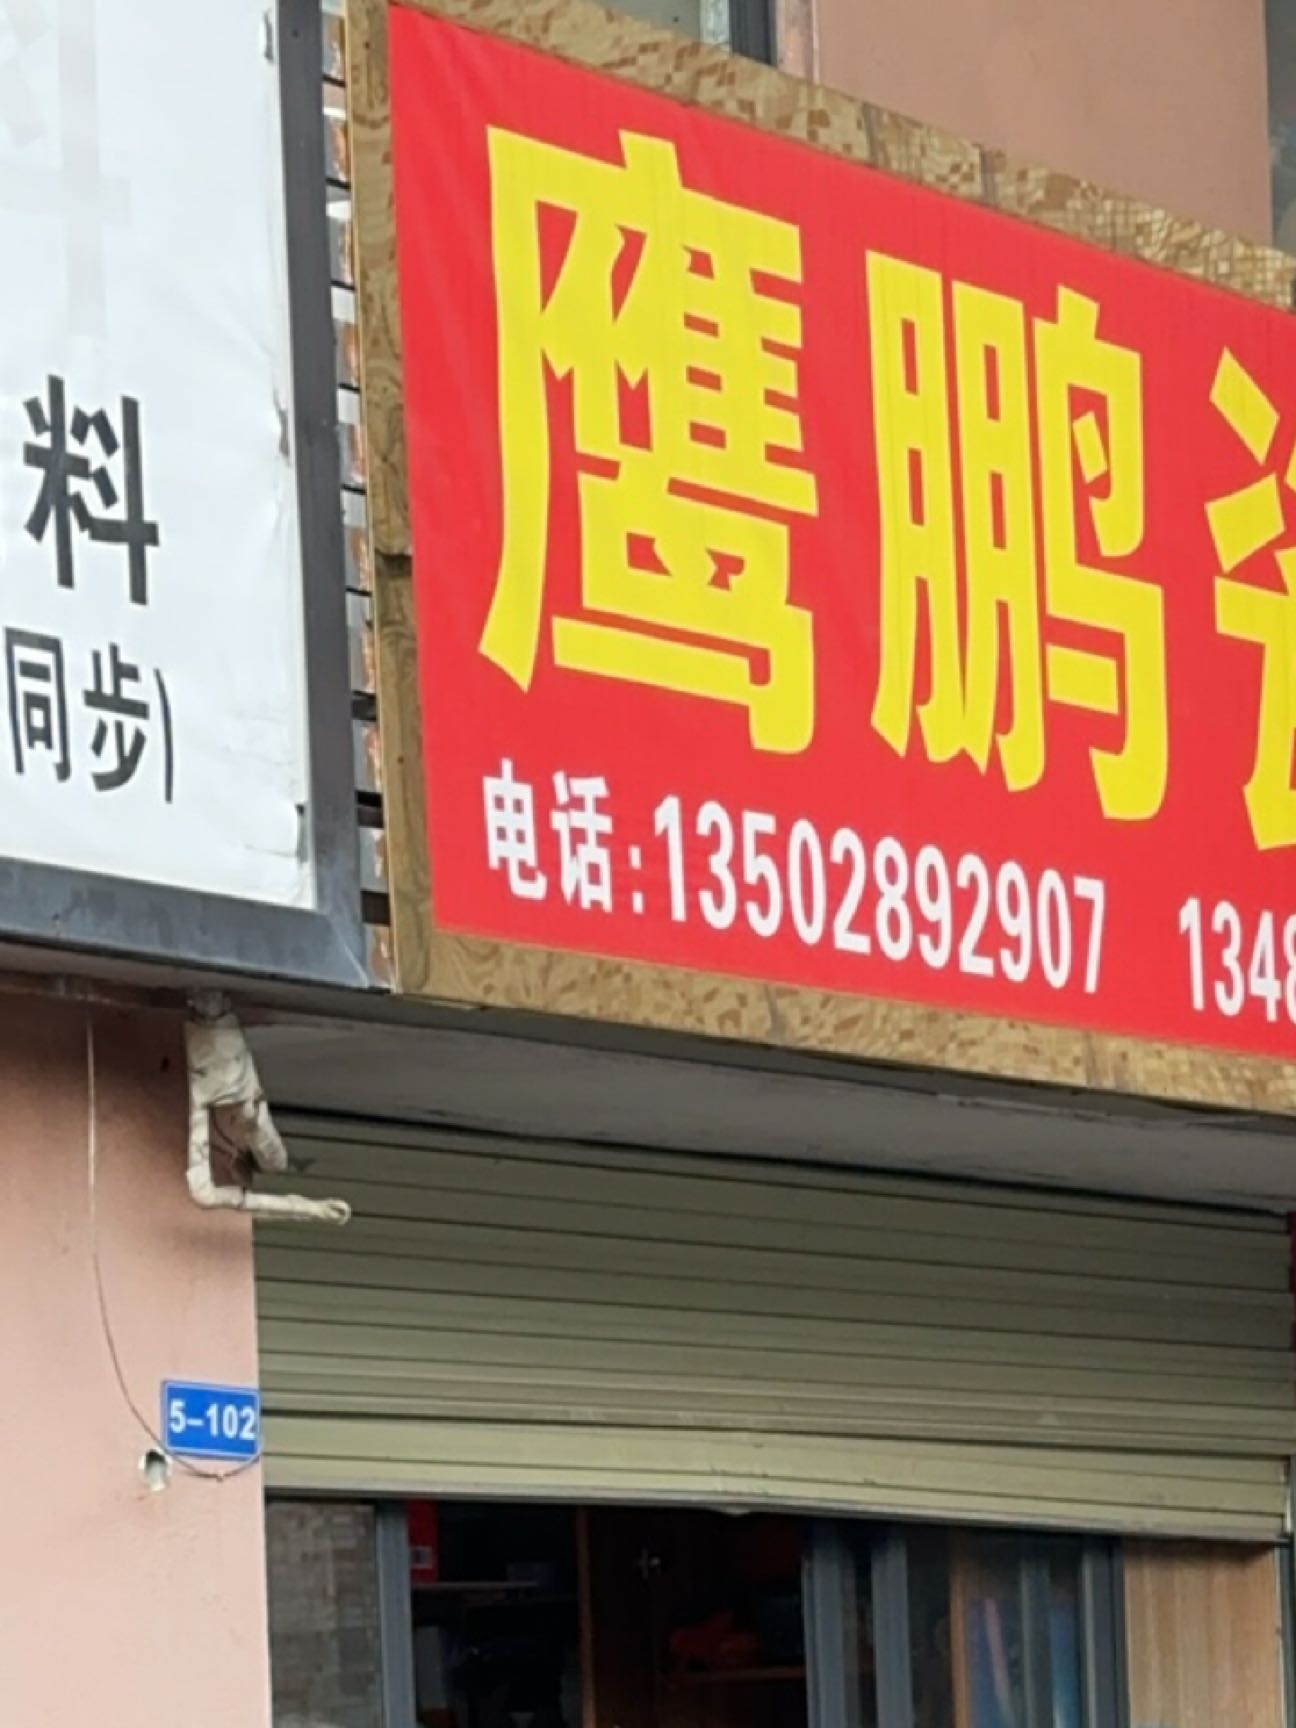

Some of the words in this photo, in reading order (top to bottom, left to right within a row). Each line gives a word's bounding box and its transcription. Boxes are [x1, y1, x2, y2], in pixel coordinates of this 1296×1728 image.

[23, 373, 159, 605] 料
[483, 758, 1106, 994] 电话:13502892907
[170, 1399, 257, 1440] 5-102
